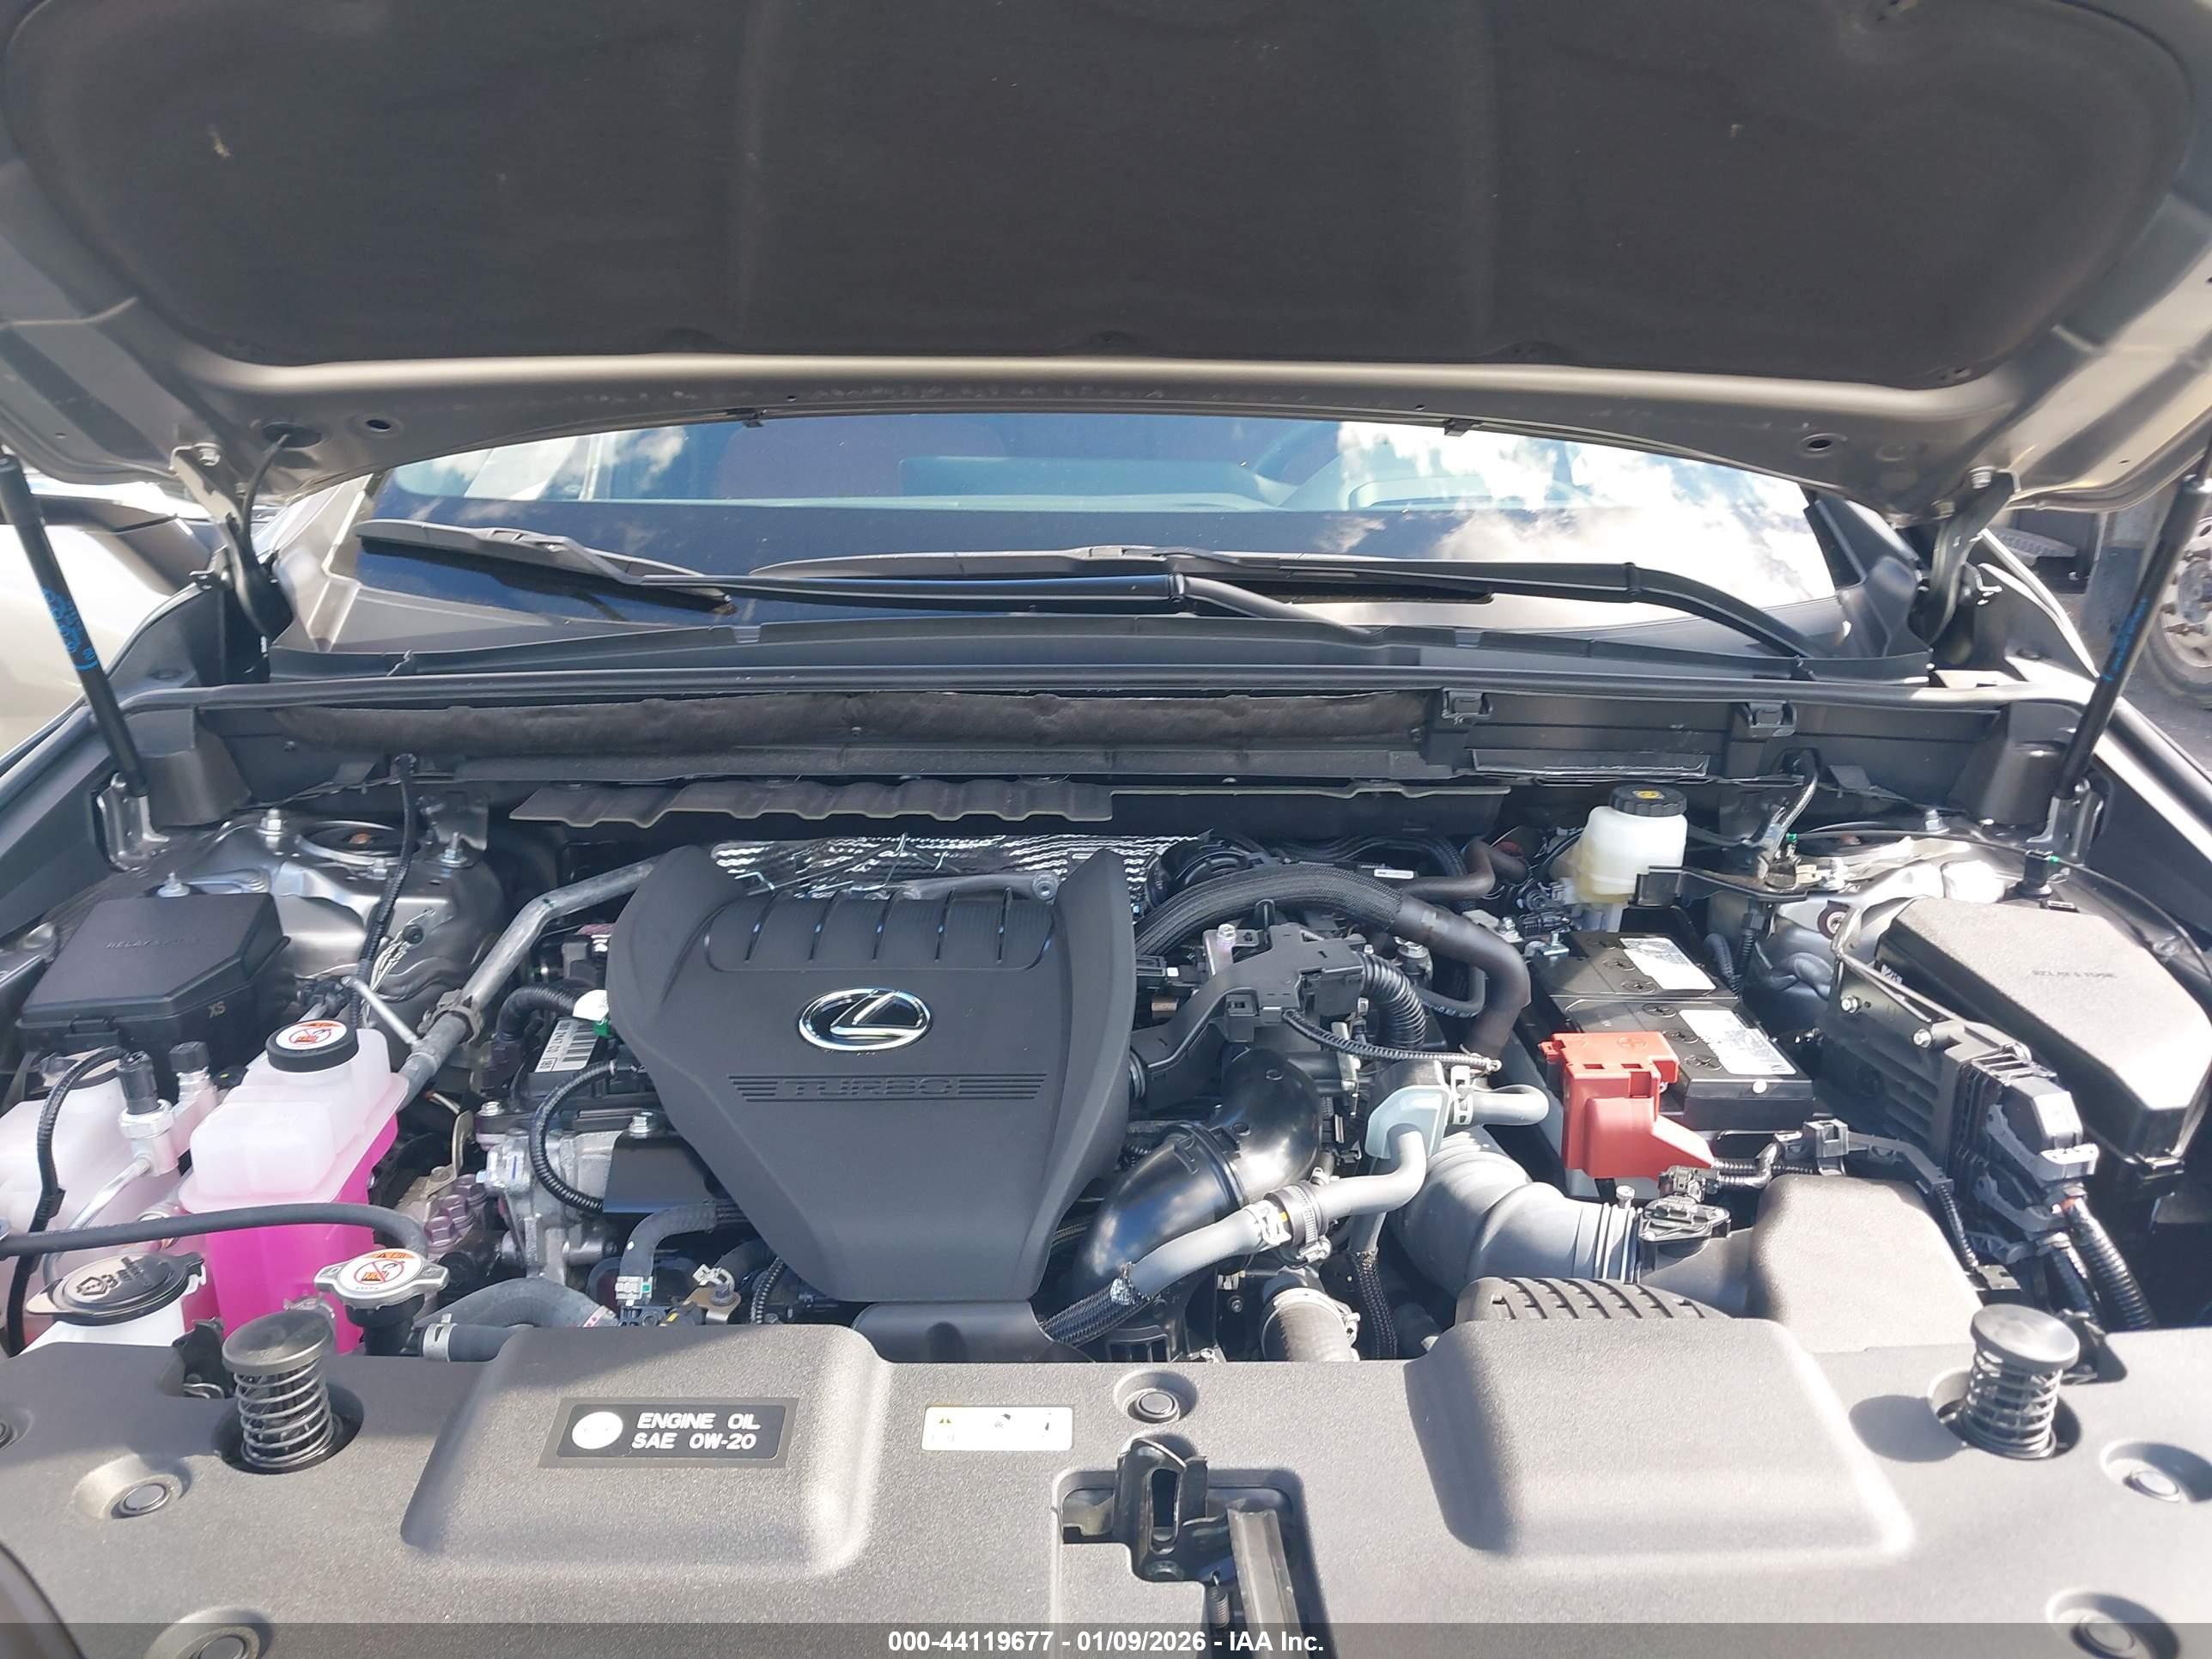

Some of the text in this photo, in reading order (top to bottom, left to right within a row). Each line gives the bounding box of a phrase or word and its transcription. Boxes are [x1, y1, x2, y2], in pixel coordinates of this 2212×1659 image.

[782, 1078, 952, 1097] TURBO
[636, 1413, 761, 1431] ENGINE OIL
[631, 1432, 678, 1449] SAE
